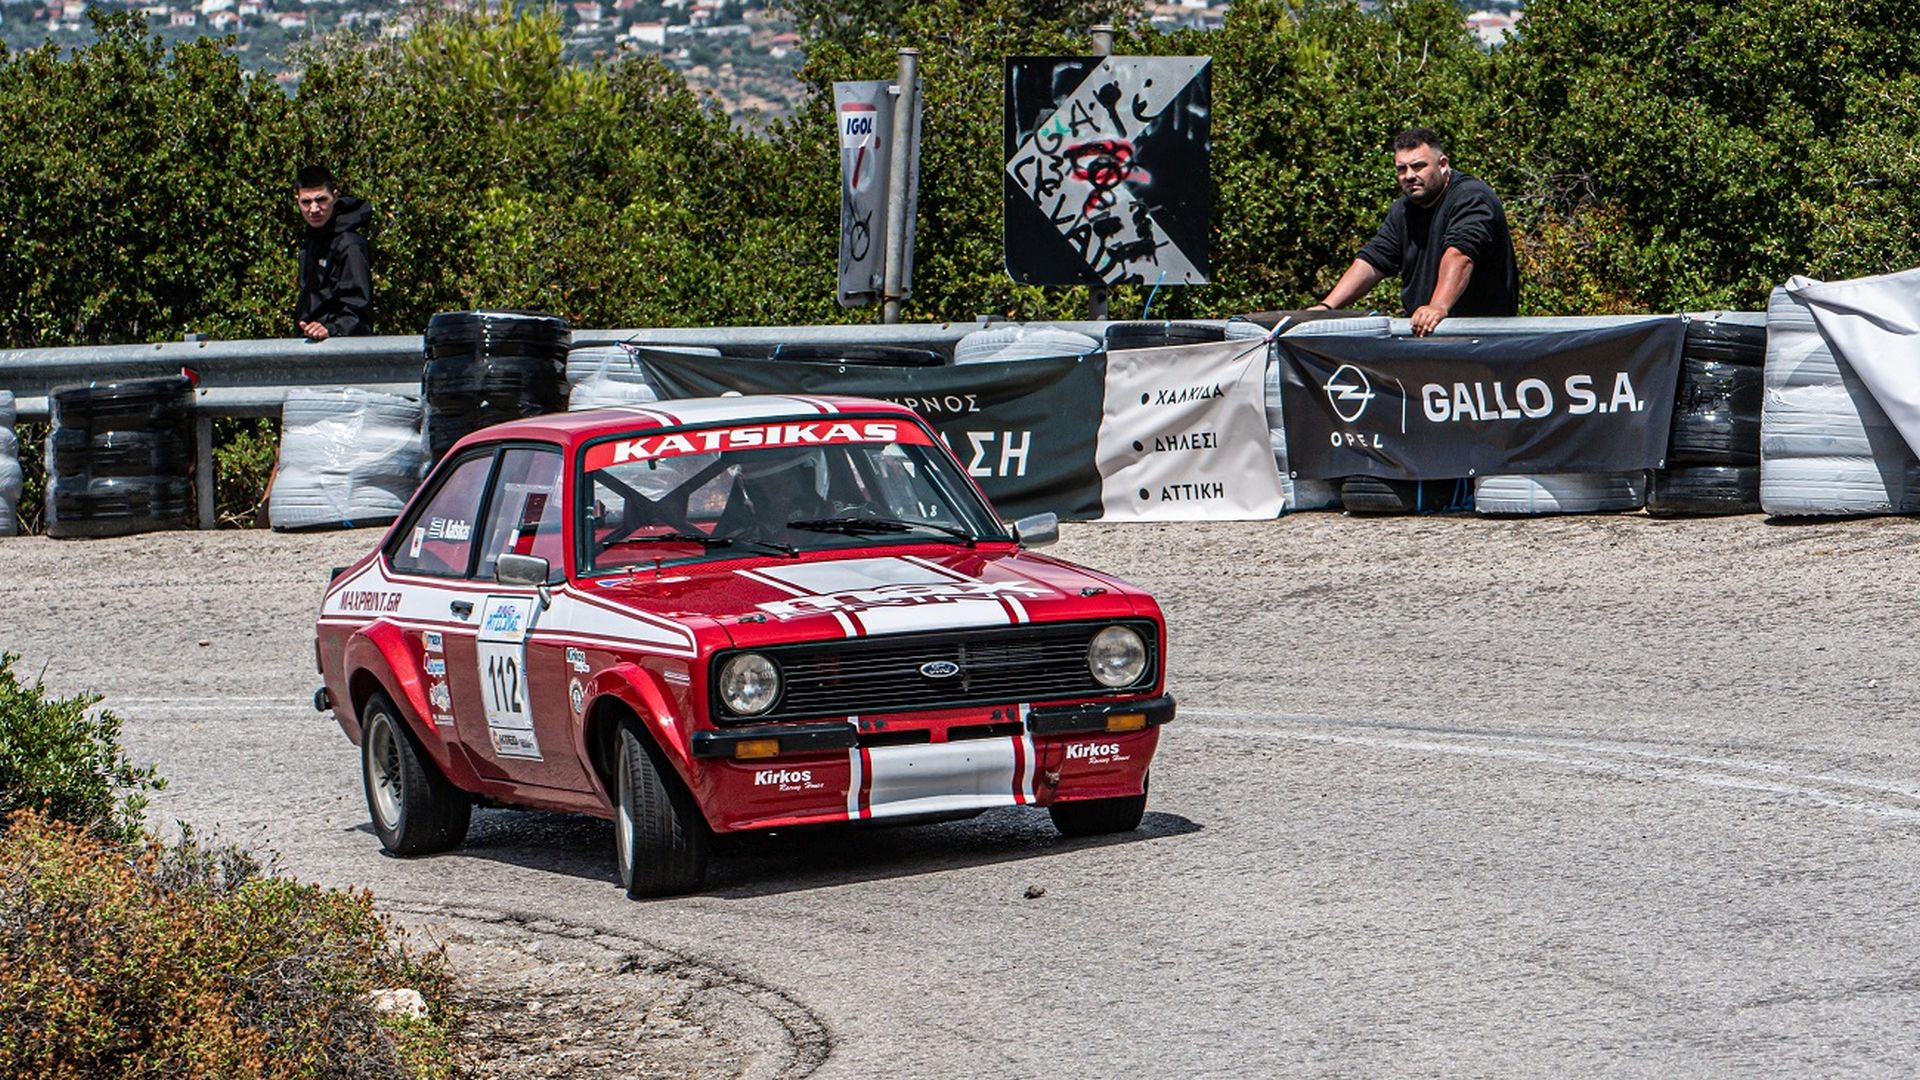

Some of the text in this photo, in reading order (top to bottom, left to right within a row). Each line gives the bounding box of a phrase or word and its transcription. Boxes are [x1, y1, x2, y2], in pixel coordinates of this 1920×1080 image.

[846, 116, 873, 136] IGOL
[1154, 382, 1225, 406] ΧΑΛΚΙΔΑ
[1421, 371, 1645, 423] GALLO S.A.
[612, 423, 898, 463] KATSIKAS
[1154, 432, 1219, 453] ΔΗΛΕΣΙ
[1330, 430, 1384, 449] OPEL
[1160, 481, 1225, 502] ΑΤΤΙΚΗ
[339, 590, 403, 612] MAXPRINT.GR
[488, 654, 523, 713] 112
[1065, 742, 1121, 760] Kirkos
[754, 769, 812, 786] Kirkos
